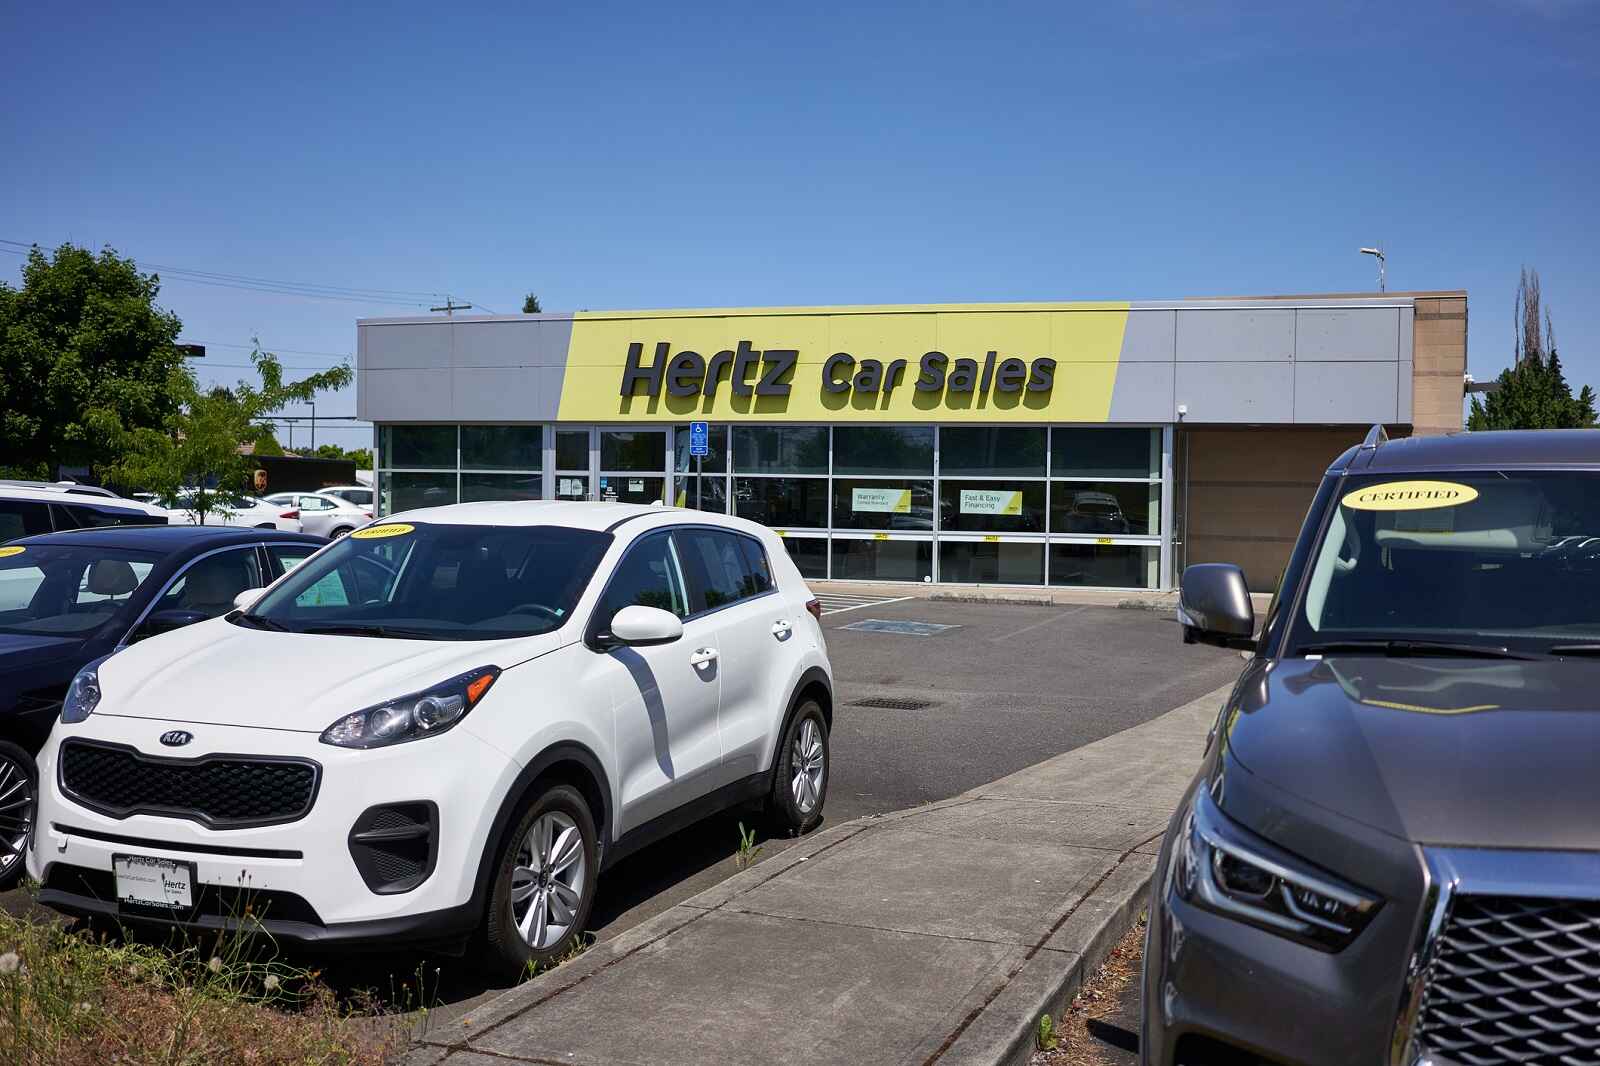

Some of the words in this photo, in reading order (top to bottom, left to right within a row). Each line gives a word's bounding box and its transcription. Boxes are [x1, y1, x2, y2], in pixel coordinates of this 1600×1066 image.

[619, 340, 799, 398] Hertz
[821, 352, 908, 393] Car
[914, 350, 1057, 393] Sales
[857, 494, 886, 502] Warranty
[986, 494, 1001, 503] Easy
[1359, 490, 1460, 502] CERTIFIED
[964, 501, 996, 510] Financing
[164, 879, 186, 890] Hertz
